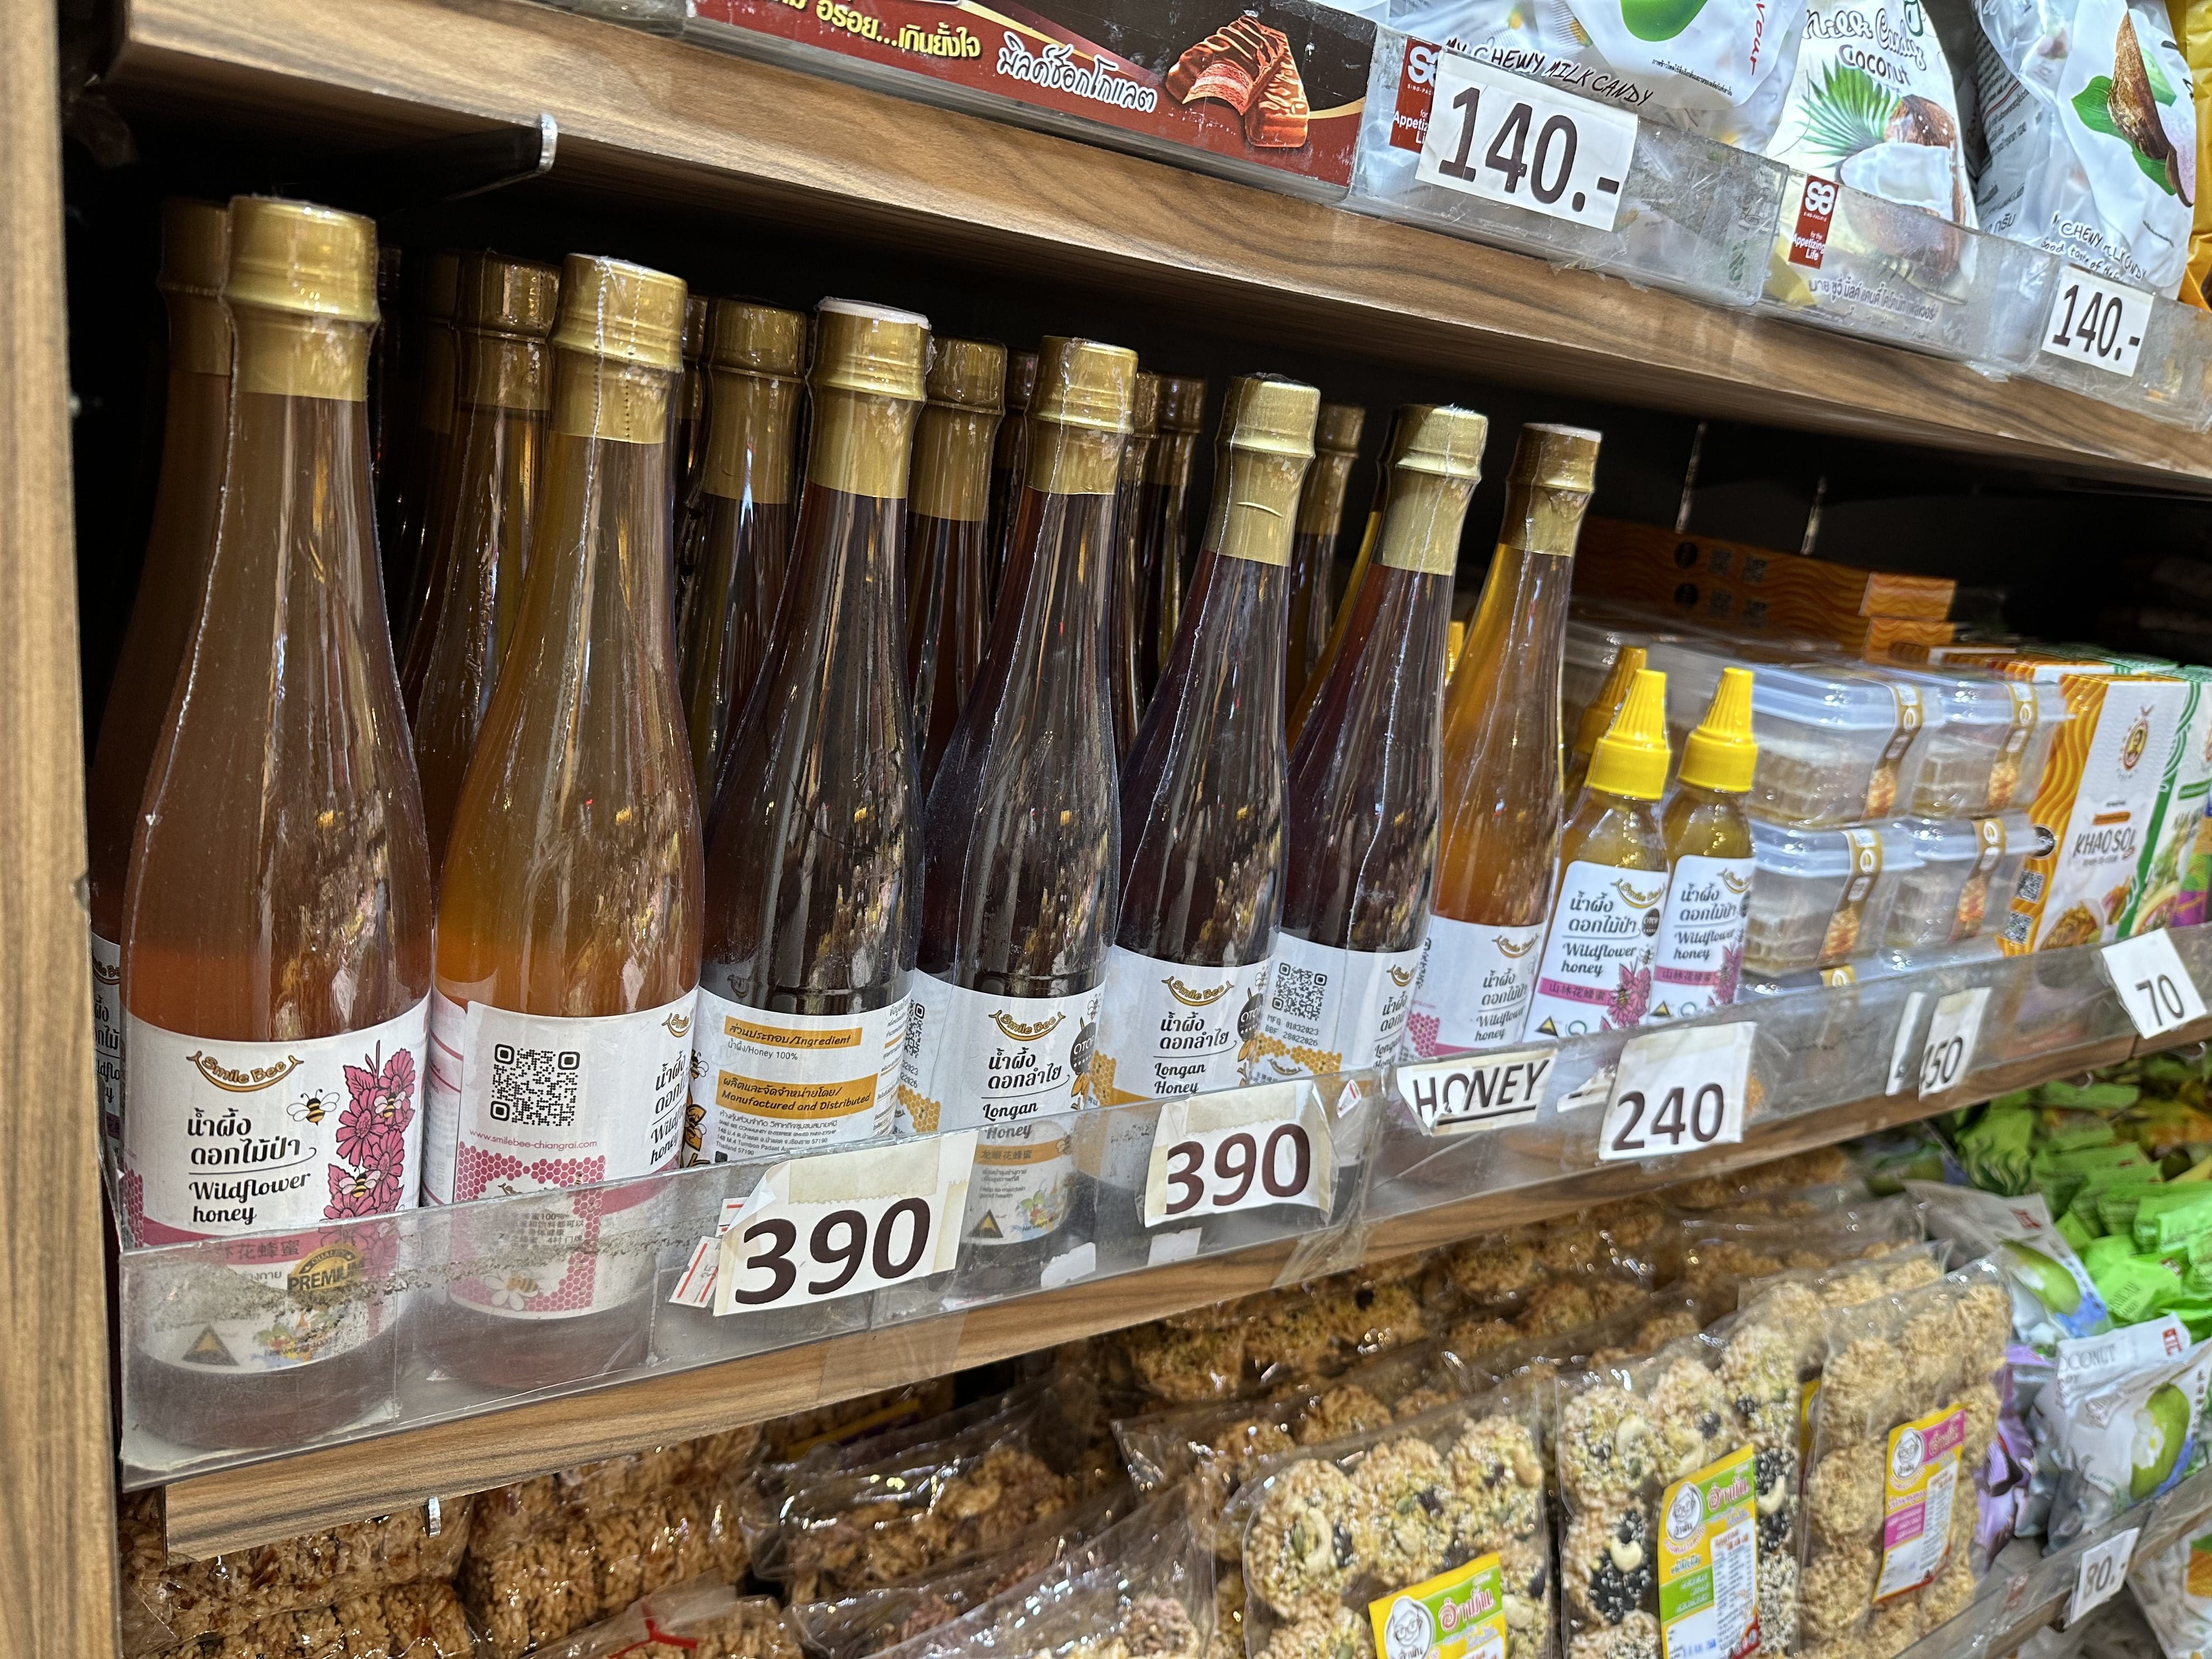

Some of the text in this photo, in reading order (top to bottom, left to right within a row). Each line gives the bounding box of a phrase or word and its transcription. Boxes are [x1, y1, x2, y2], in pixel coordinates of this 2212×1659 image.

[1802, 8, 1926, 71] Milk Candy
[1474, 46, 1545, 72] CHEWY
[1546, 60, 1594, 87] MILK
[1592, 75, 1654, 106] CANDY
[1407, 83, 1433, 96] SING-PAC
[1393, 110, 1429, 131] Appetiz
[1415, 130, 1426, 145] Li
[1438, 86, 1621, 212] 140.-
[1792, 233, 1826, 255] Appetizing
[2061, 222, 2103, 247] CHEWY
[1805, 248, 1819, 261] Life
[2052, 284, 2141, 361] 140.-
[1570, 890, 1614, 912] น้ำผึ้ง
[1568, 915, 1637, 933] ดอกไม้ป่า
[1674, 928, 1736, 946] Wildflower
[1562, 942, 1638, 962] Wildflower
[1673, 947, 1711, 961] honey
[1482, 967, 1516, 989] น้ำผึ้ง
[1561, 960, 1604, 978] honey
[1172, 980, 1224, 1001] Smile Bee
[2135, 974, 2185, 1026] 70
[1000, 1014, 1057, 1035] Smile Bee
[1160, 1011, 1205, 1032] น้ำผึ้ง
[1267, 1014, 1282, 1026] MFG
[1159, 1028, 1229, 1049] ดอกลำไย
[1474, 1028, 1506, 1042] honey
[776, 1051, 798, 1060] 100%
[988, 1047, 1036, 1070] น้ำผึ้ง
[201, 1056, 287, 1084] Smile Bee
[988, 1063, 1062, 1090] ดอกลำไย
[1154, 1062, 1207, 1080] Longan
[1154, 1080, 1199, 1094] Honey
[1413, 1058, 1550, 1118] HONEY
[722, 1090, 871, 1111] Manufactured and Distributed
[188, 1107, 252, 1137] น้ำผึ้ง
[983, 1102, 1039, 1122] Longan
[1611, 1083, 1725, 1152] 240
[469, 1128, 598, 1152] www.smilebee-chiangrai.com
[984, 1124, 1033, 1139] Honey
[190, 1135, 301, 1165] ดอกไม้ป่า
[1164, 1123, 1311, 1215] 390
[188, 1172, 311, 1204] Wildflower
[193, 1205, 257, 1226] honey
[735, 1197, 931, 1305] 390
